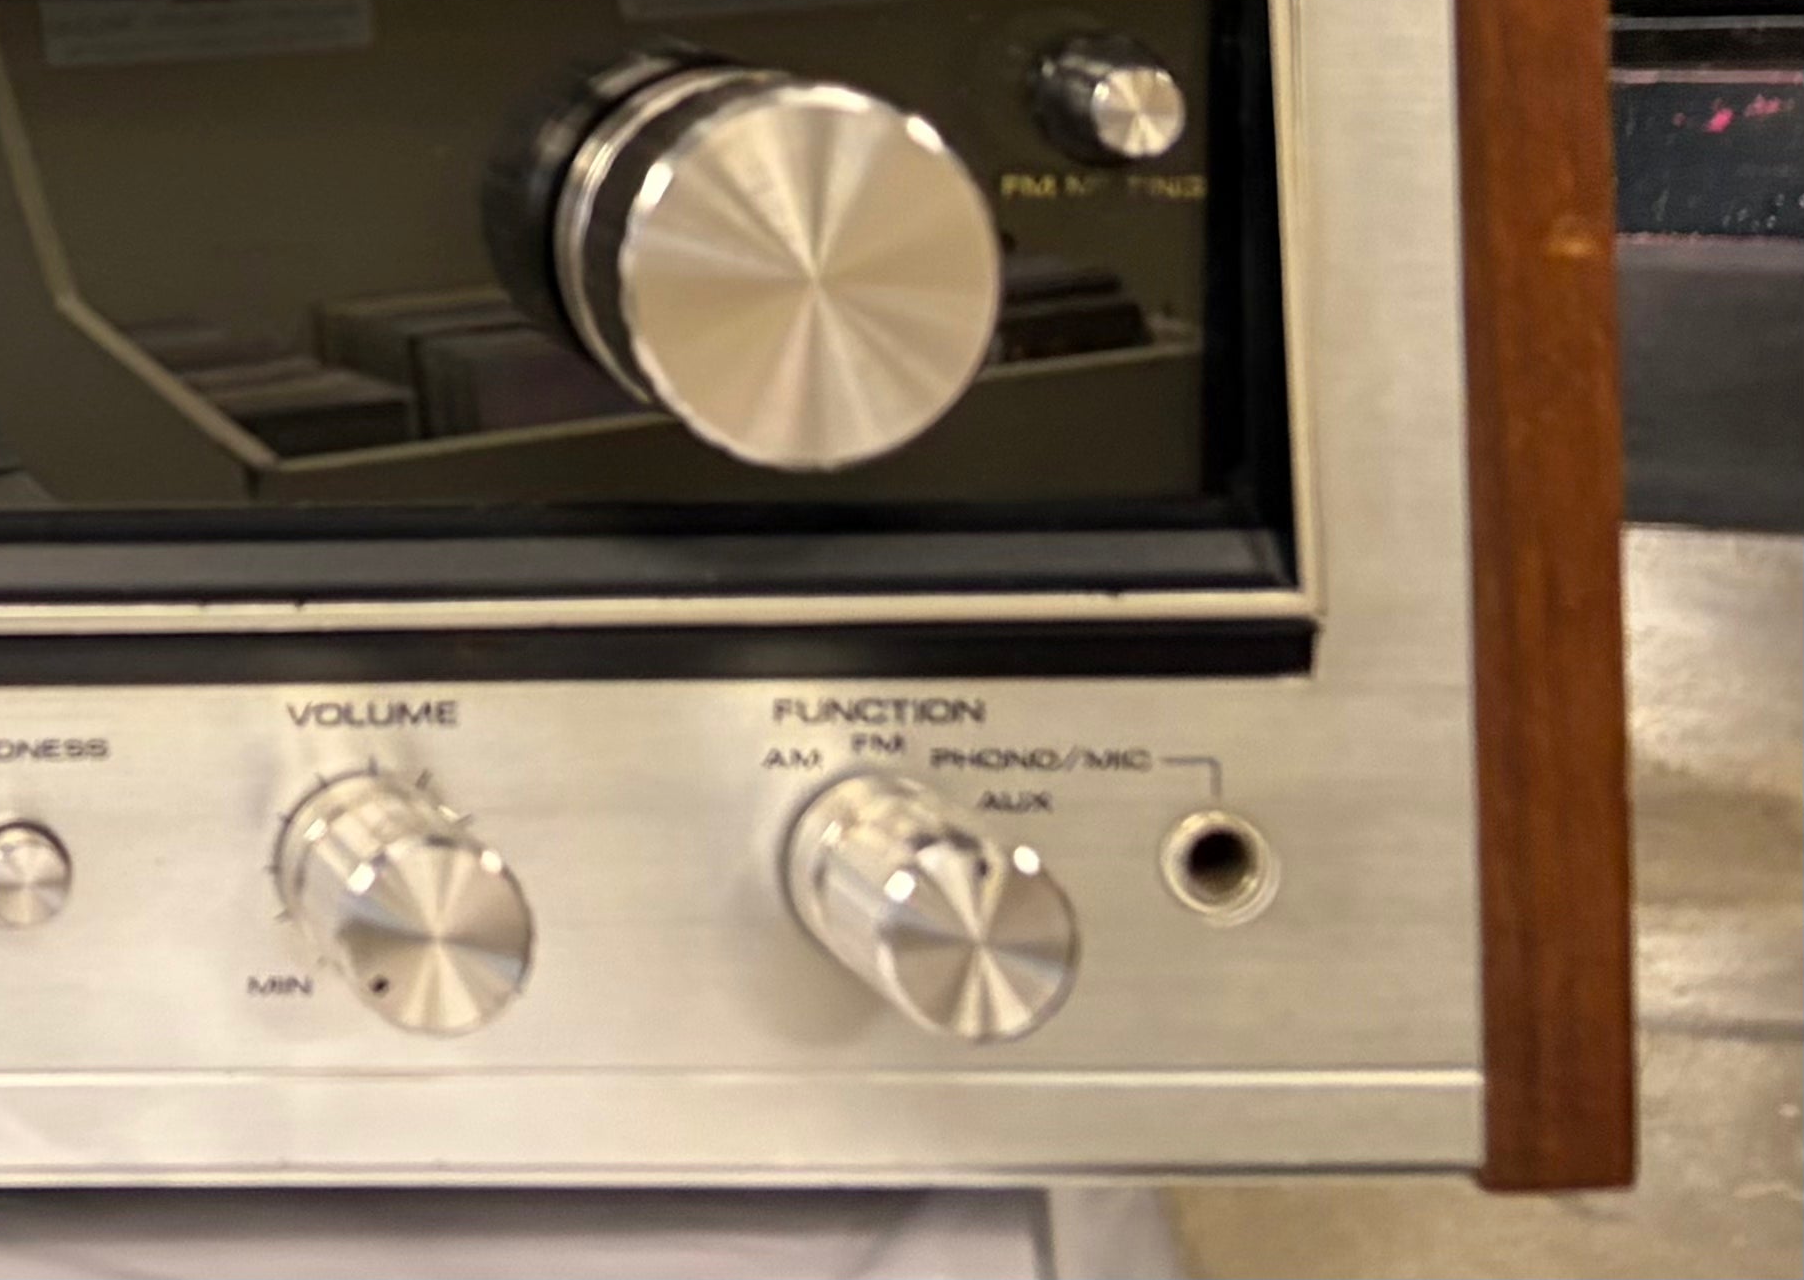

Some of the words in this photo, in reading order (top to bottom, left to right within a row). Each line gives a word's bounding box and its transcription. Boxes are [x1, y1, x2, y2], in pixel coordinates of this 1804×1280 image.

[1001, 173, 1056, 199] FM
[1065, 173, 1208, 199] MTING
[286, 699, 460, 728] VOLUME
[772, 698, 987, 725] FUNCTION
[850, 733, 906, 755] FM
[762, 747, 823, 770] AM
[928, 746, 1154, 772] PHONO/MIC
[978, 790, 1053, 813] AUX
[247, 975, 313, 997] MIN
